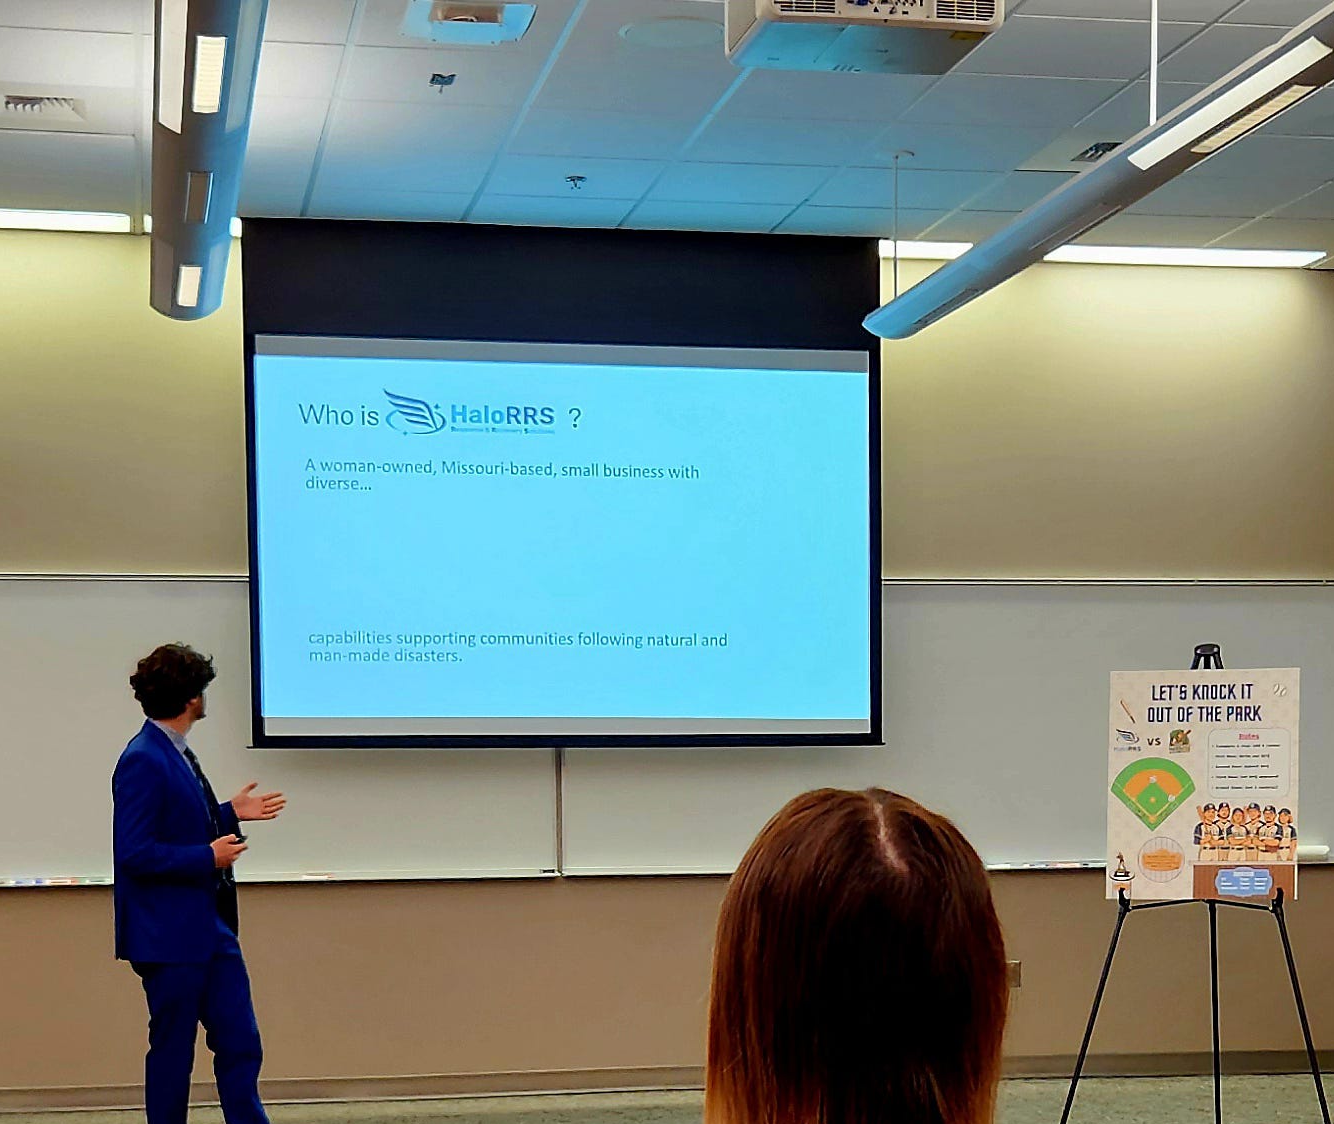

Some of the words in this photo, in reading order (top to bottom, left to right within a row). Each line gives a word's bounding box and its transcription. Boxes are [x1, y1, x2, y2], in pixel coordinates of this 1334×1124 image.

[299, 403, 354, 426] Who
[361, 405, 380, 426] is
[451, 404, 555, 425] HaloRRS
[568, 407, 582, 428] ?
[305, 458, 316, 472] A
[320, 460, 437, 476] woman-owned,
[442, 461, 557, 478] Missouri-based,
[561, 463, 599, 477] small
[603, 464, 664, 478] business
[668, 465, 700, 479] with
[305, 476, 372, 491] diverse...
[308, 631, 392, 647] capabilities
[396, 632, 476, 648] supporting
[480, 632, 574, 646] communities
[578, 632, 643, 649] following
[647, 633, 697, 647] natural
[701, 633, 728, 647] and
[309, 648, 390, 662] man-made
[394, 648, 463, 662] disasters.
[1151, 684, 1188, 701] LET'S
[1192, 684, 1237, 700] KNOCK
[1241, 683, 1254, 699] IT
[1147, 706, 1173, 722] OUT
[1177, 706, 1194, 722] OF
[1197, 706, 1222, 722] THE
[1226, 705, 1262, 722] PARK
